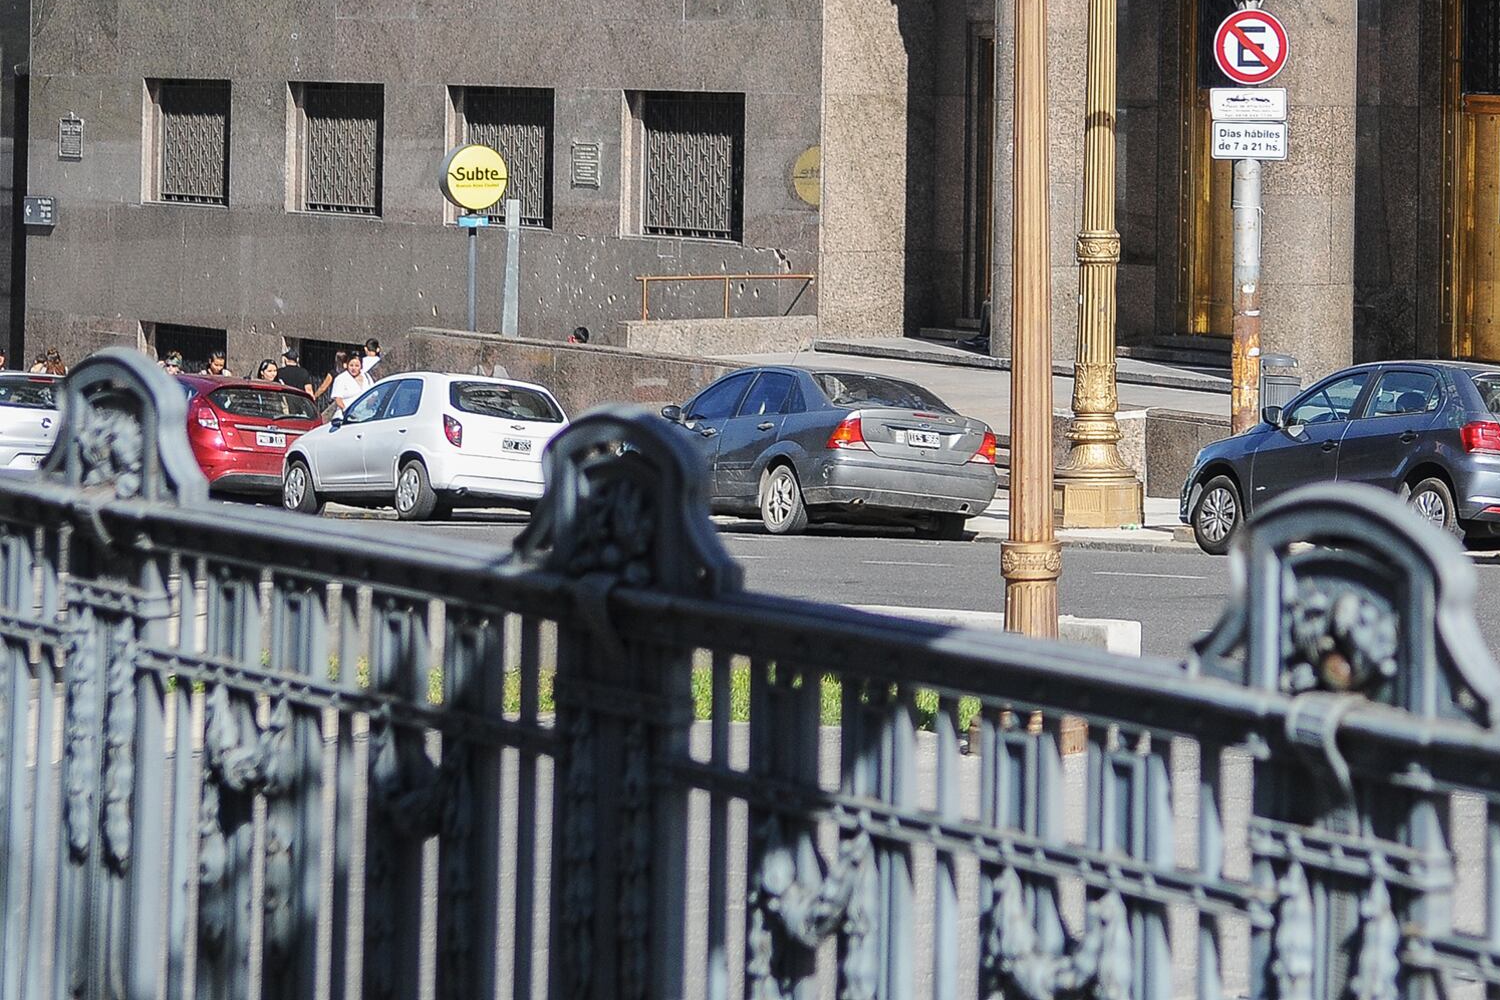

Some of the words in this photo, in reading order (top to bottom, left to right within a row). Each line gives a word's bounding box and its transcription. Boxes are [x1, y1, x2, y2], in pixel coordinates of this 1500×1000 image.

[1218, 142, 1231, 150] de
[1233, 142, 1240, 150] 7
[1251, 142, 1262, 151] 21
[455, 166, 499, 181] Subte
